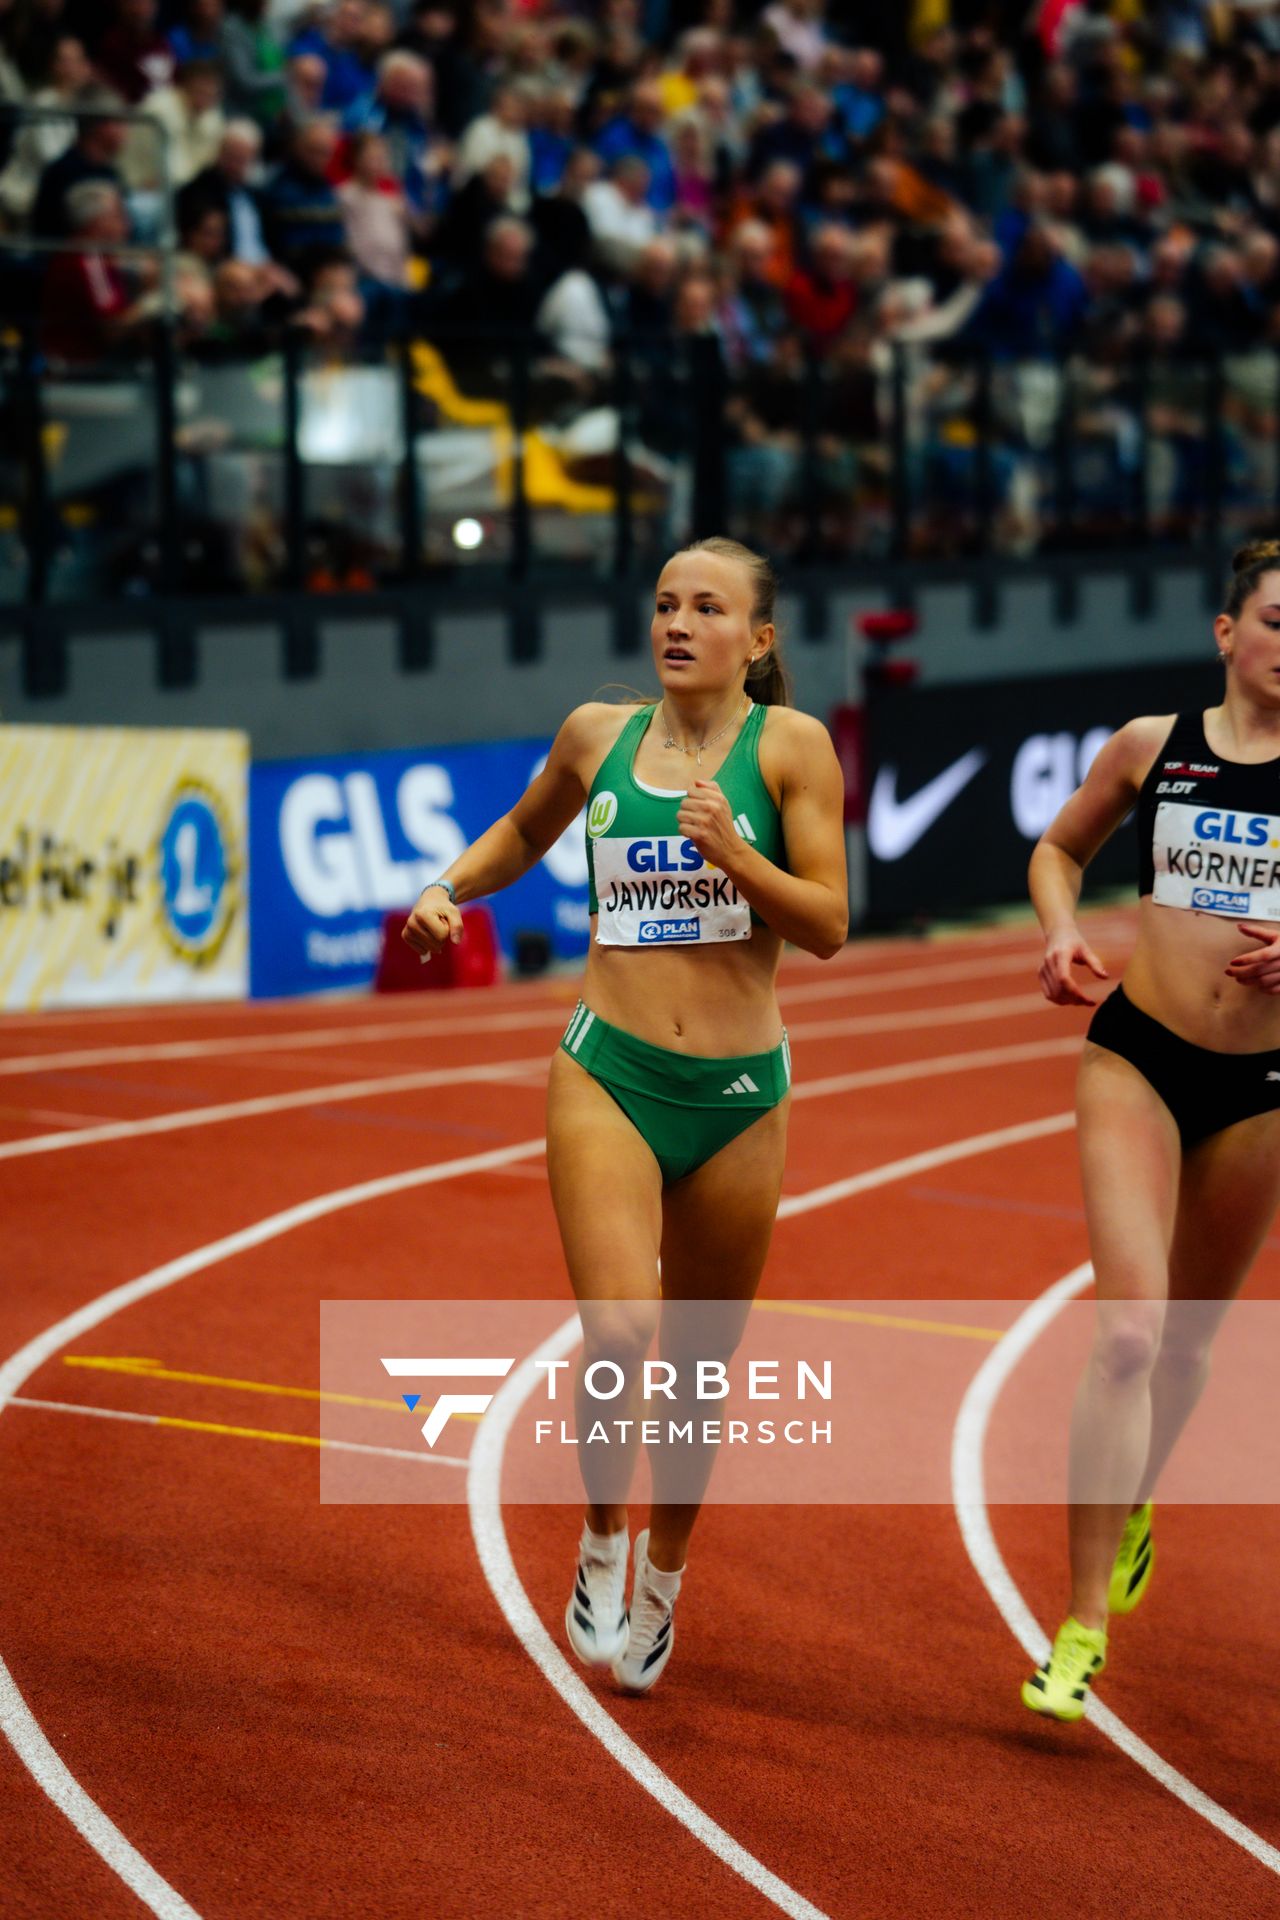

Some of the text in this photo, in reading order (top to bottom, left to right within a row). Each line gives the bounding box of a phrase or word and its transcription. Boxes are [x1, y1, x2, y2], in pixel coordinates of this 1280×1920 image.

[1189, 763, 1220, 773] TEAM
[1167, 841, 1280, 889] KÖRNER
[606, 877, 738, 912] JAWORSKI
[1214, 893, 1249, 907] PLAN
[662, 921, 698, 934] PLAN
[718, 928, 737, 938] 308
